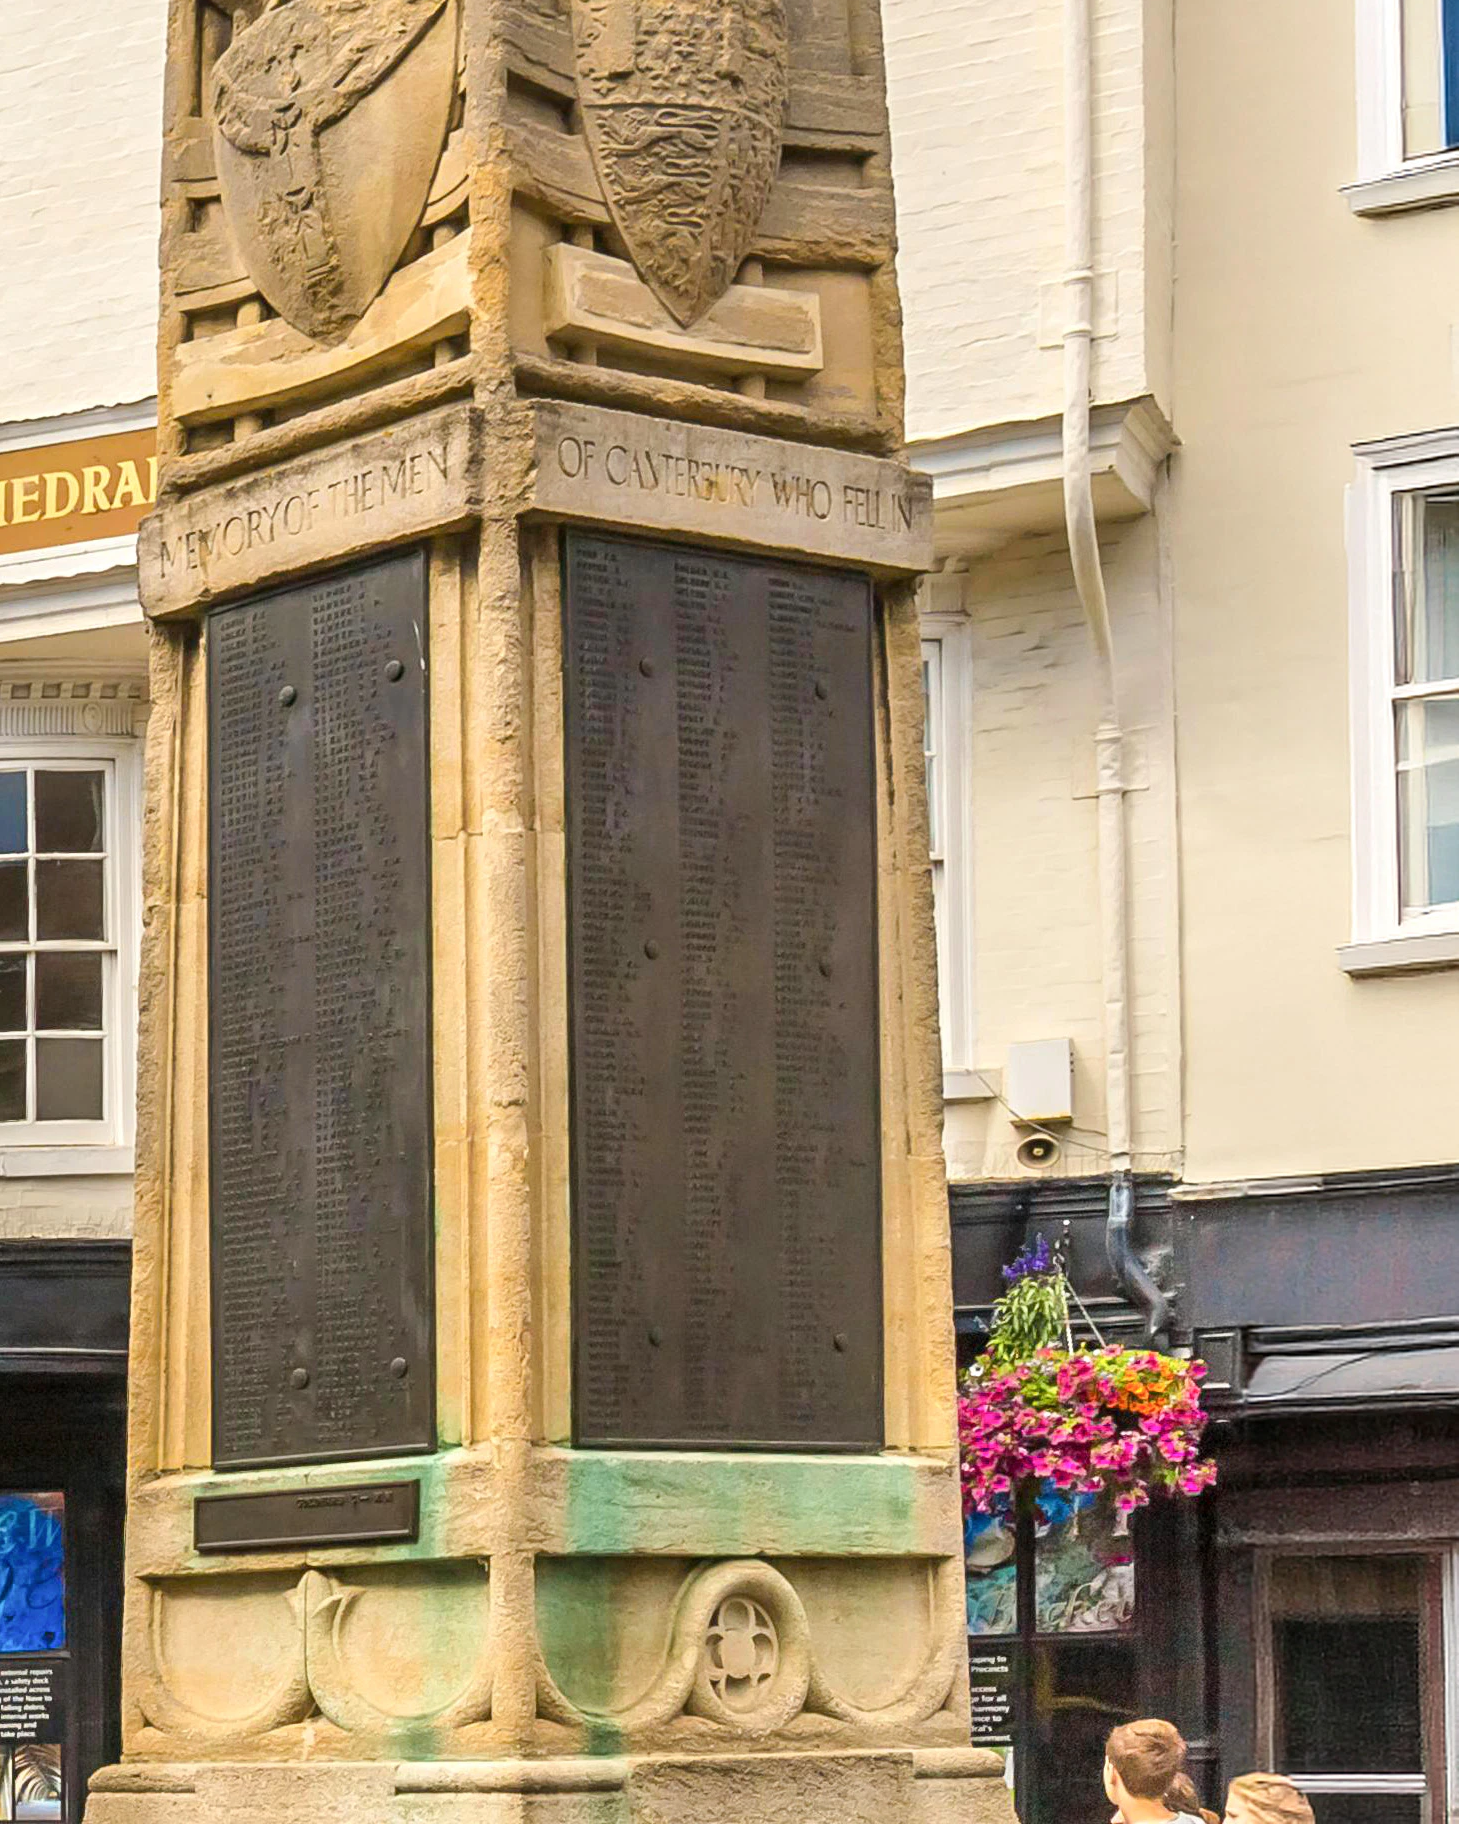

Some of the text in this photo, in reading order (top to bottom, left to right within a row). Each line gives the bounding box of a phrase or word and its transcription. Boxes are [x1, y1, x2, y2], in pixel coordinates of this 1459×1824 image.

[284, 489, 320, 535] OF
[328, 470, 374, 518] THE
[380, 441, 449, 506] MEN
[558, 436, 914, 534] OF CANTERBURY WHO FELL IN
